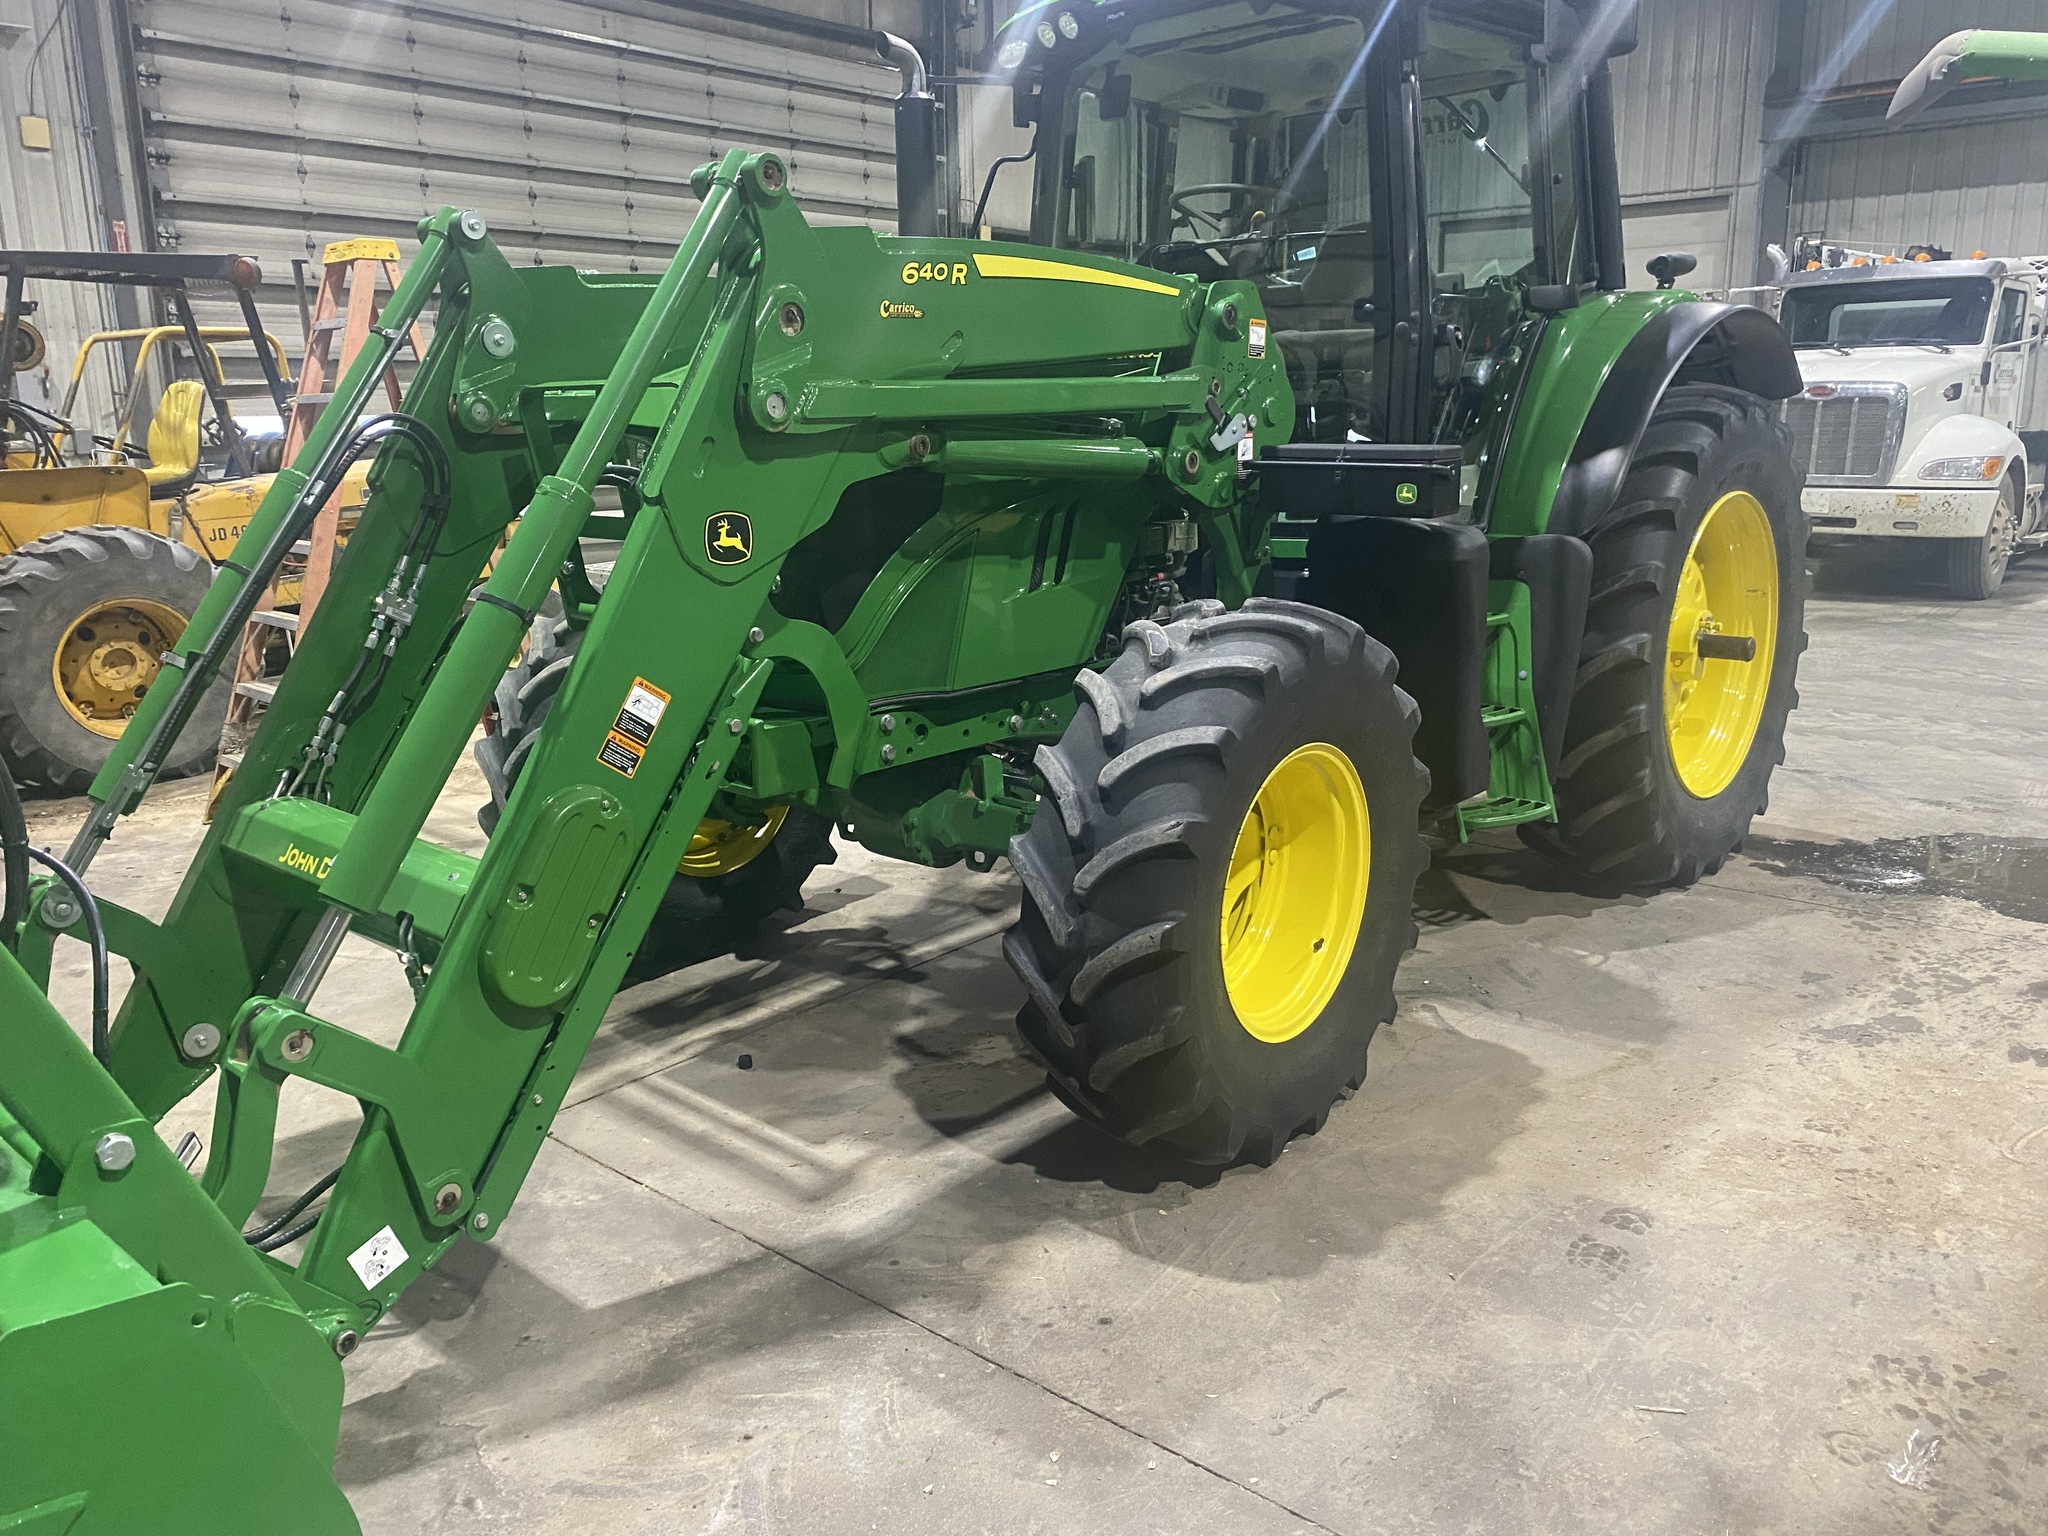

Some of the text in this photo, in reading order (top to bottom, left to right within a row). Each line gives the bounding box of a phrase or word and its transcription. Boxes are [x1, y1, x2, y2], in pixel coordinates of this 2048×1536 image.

[880, 299, 915, 318] Carrico
[209, 528, 226, 541] JD
[644, 683, 667, 700] WARNING
[618, 738, 641, 754] WARNING
[279, 843, 331, 879] JOHN D
